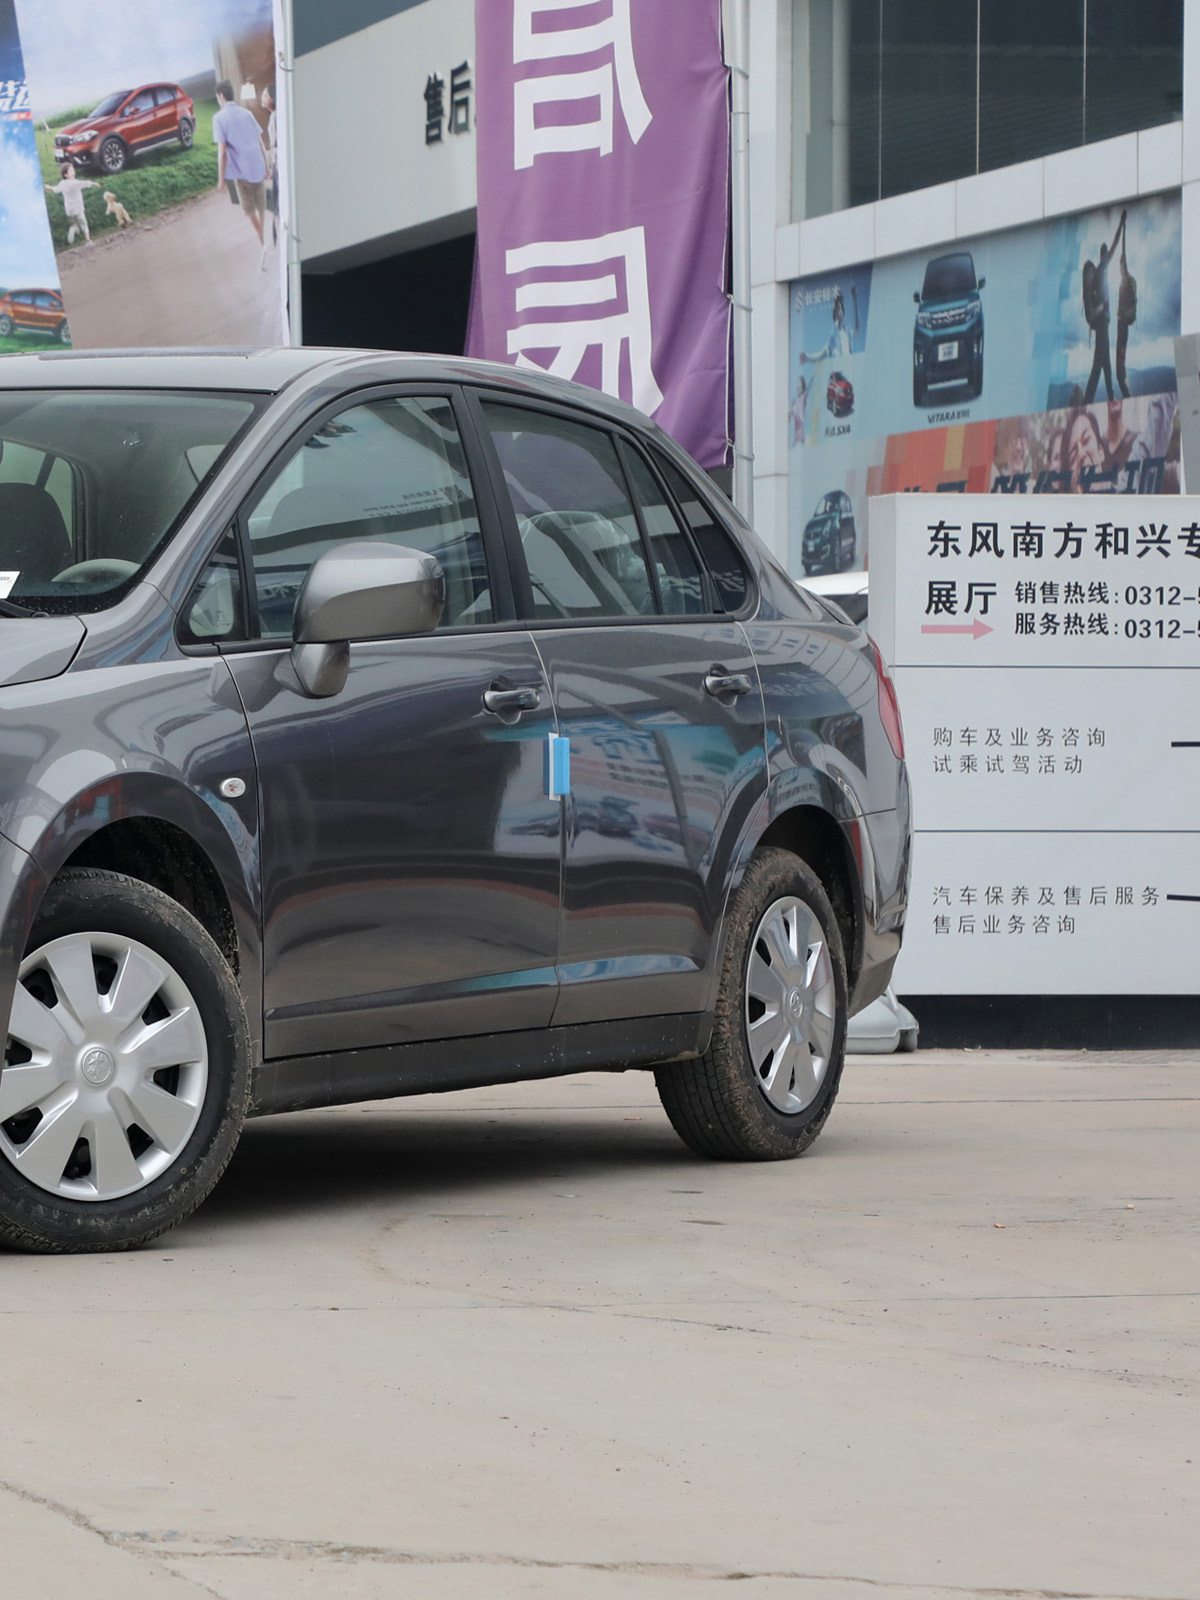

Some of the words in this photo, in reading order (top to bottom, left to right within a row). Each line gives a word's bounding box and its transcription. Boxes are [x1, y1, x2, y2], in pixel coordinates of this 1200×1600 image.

[925, 580, 997, 616] 展厅
[1015, 581, 1200, 606] 销售热线:0312-
[1015, 612, 1200, 639] 服务热线:0312-
[933, 727, 1106, 748] 购车及业务咨询
[933, 755, 1082, 775] 试乘试驾活动
[933, 886, 1160, 906] 汽车保养及售后服务
[933, 915, 1075, 935] 售后业务咨询
